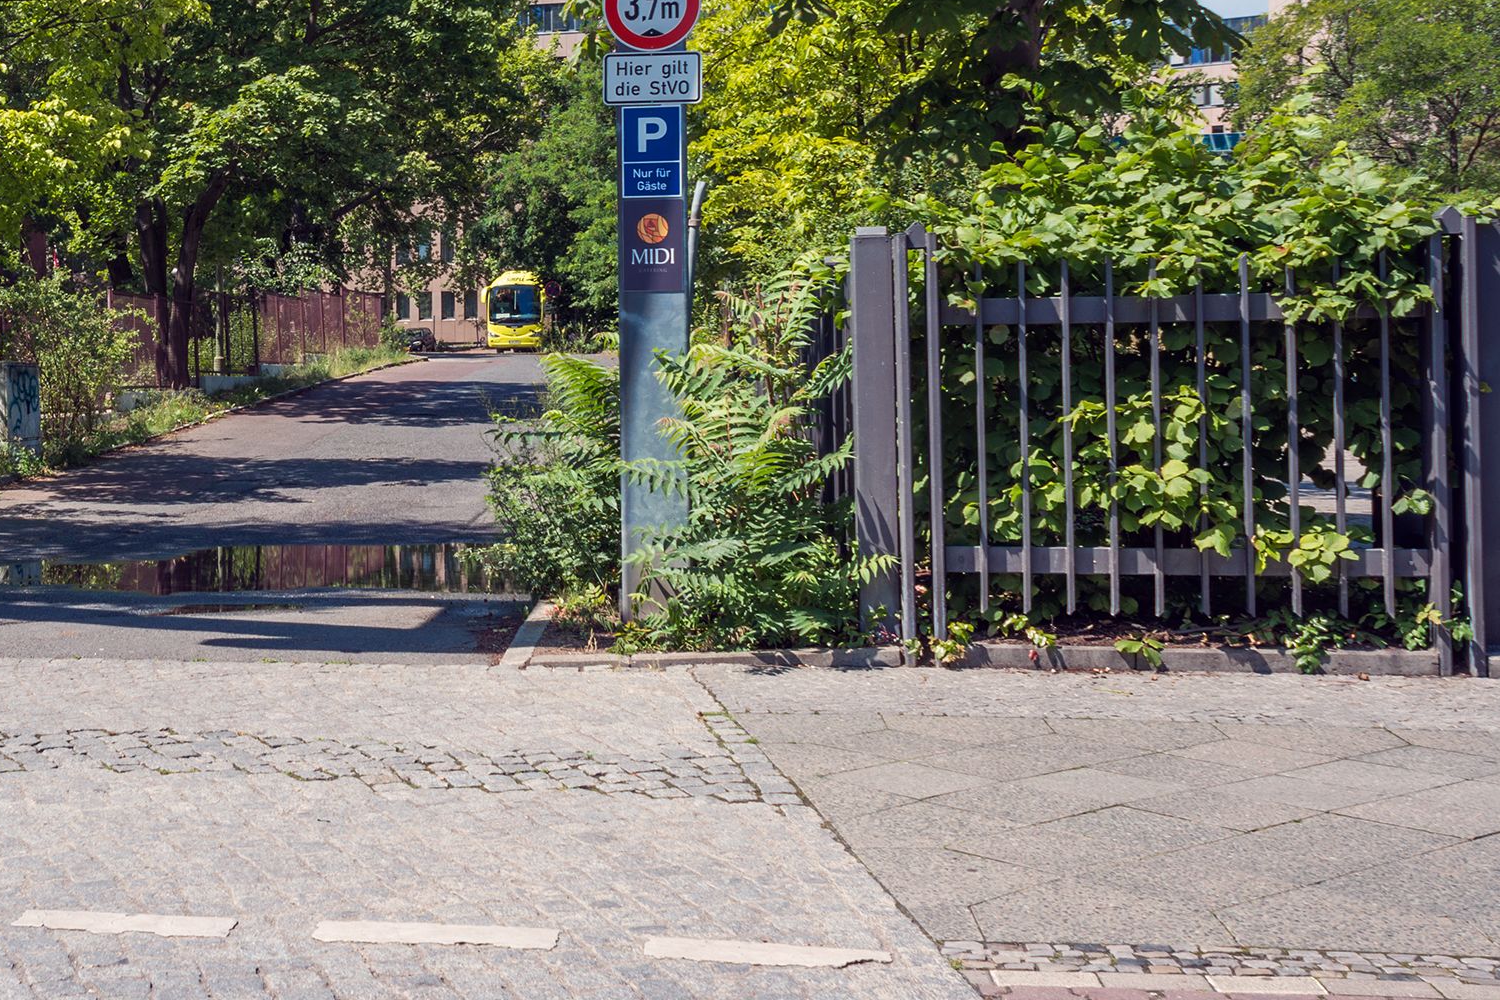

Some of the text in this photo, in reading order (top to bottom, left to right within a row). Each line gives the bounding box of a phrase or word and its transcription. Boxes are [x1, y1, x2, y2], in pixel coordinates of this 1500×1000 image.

[616, 61, 688, 79] Hier gilt
[615, 80, 690, 96] die StVO
[637, 117, 668, 153] P
[633, 167, 671, 179] Nur für
[637, 179, 667, 191] Gäste
[631, 247, 675, 265] MIDI
